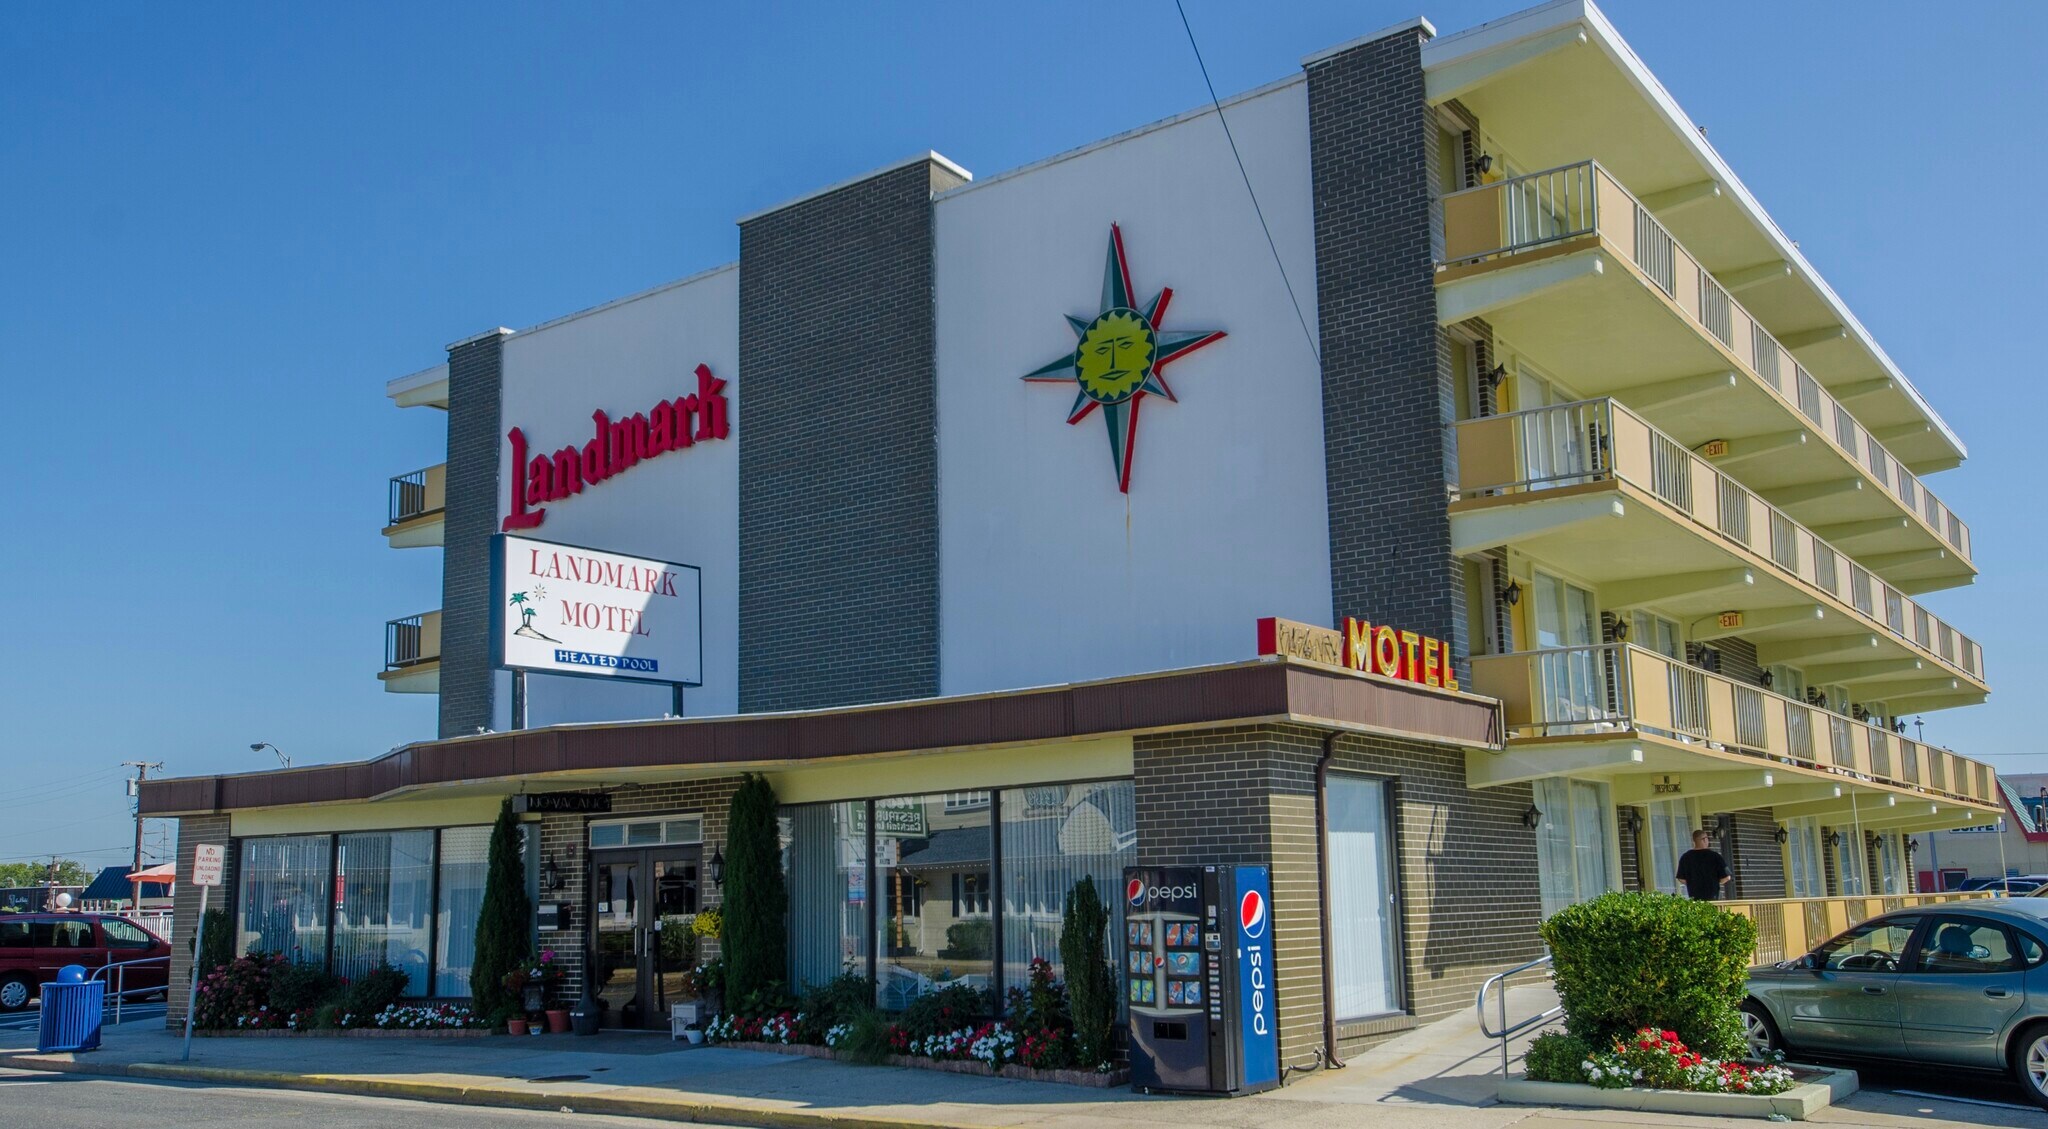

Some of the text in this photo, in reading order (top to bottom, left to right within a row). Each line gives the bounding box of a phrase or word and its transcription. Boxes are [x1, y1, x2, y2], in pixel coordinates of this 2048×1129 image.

[502, 363, 731, 532] Landmark
[1708, 443, 1724, 456] EXIT
[529, 548, 679, 598] LANDMARK
[560, 599, 650, 638] MOTEL
[1722, 614, 1739, 627] EXIT
[558, 651, 655, 672] HEATED POOL
[1344, 616, 1459, 692] MOTEL
[1653, 783, 1681, 793] TRESPASSING
[529, 796, 549, 808] NO
[205, 848, 216, 856] NO
[1148, 883, 1197, 902] pepsi
[1247, 945, 1268, 1036] pepsi
